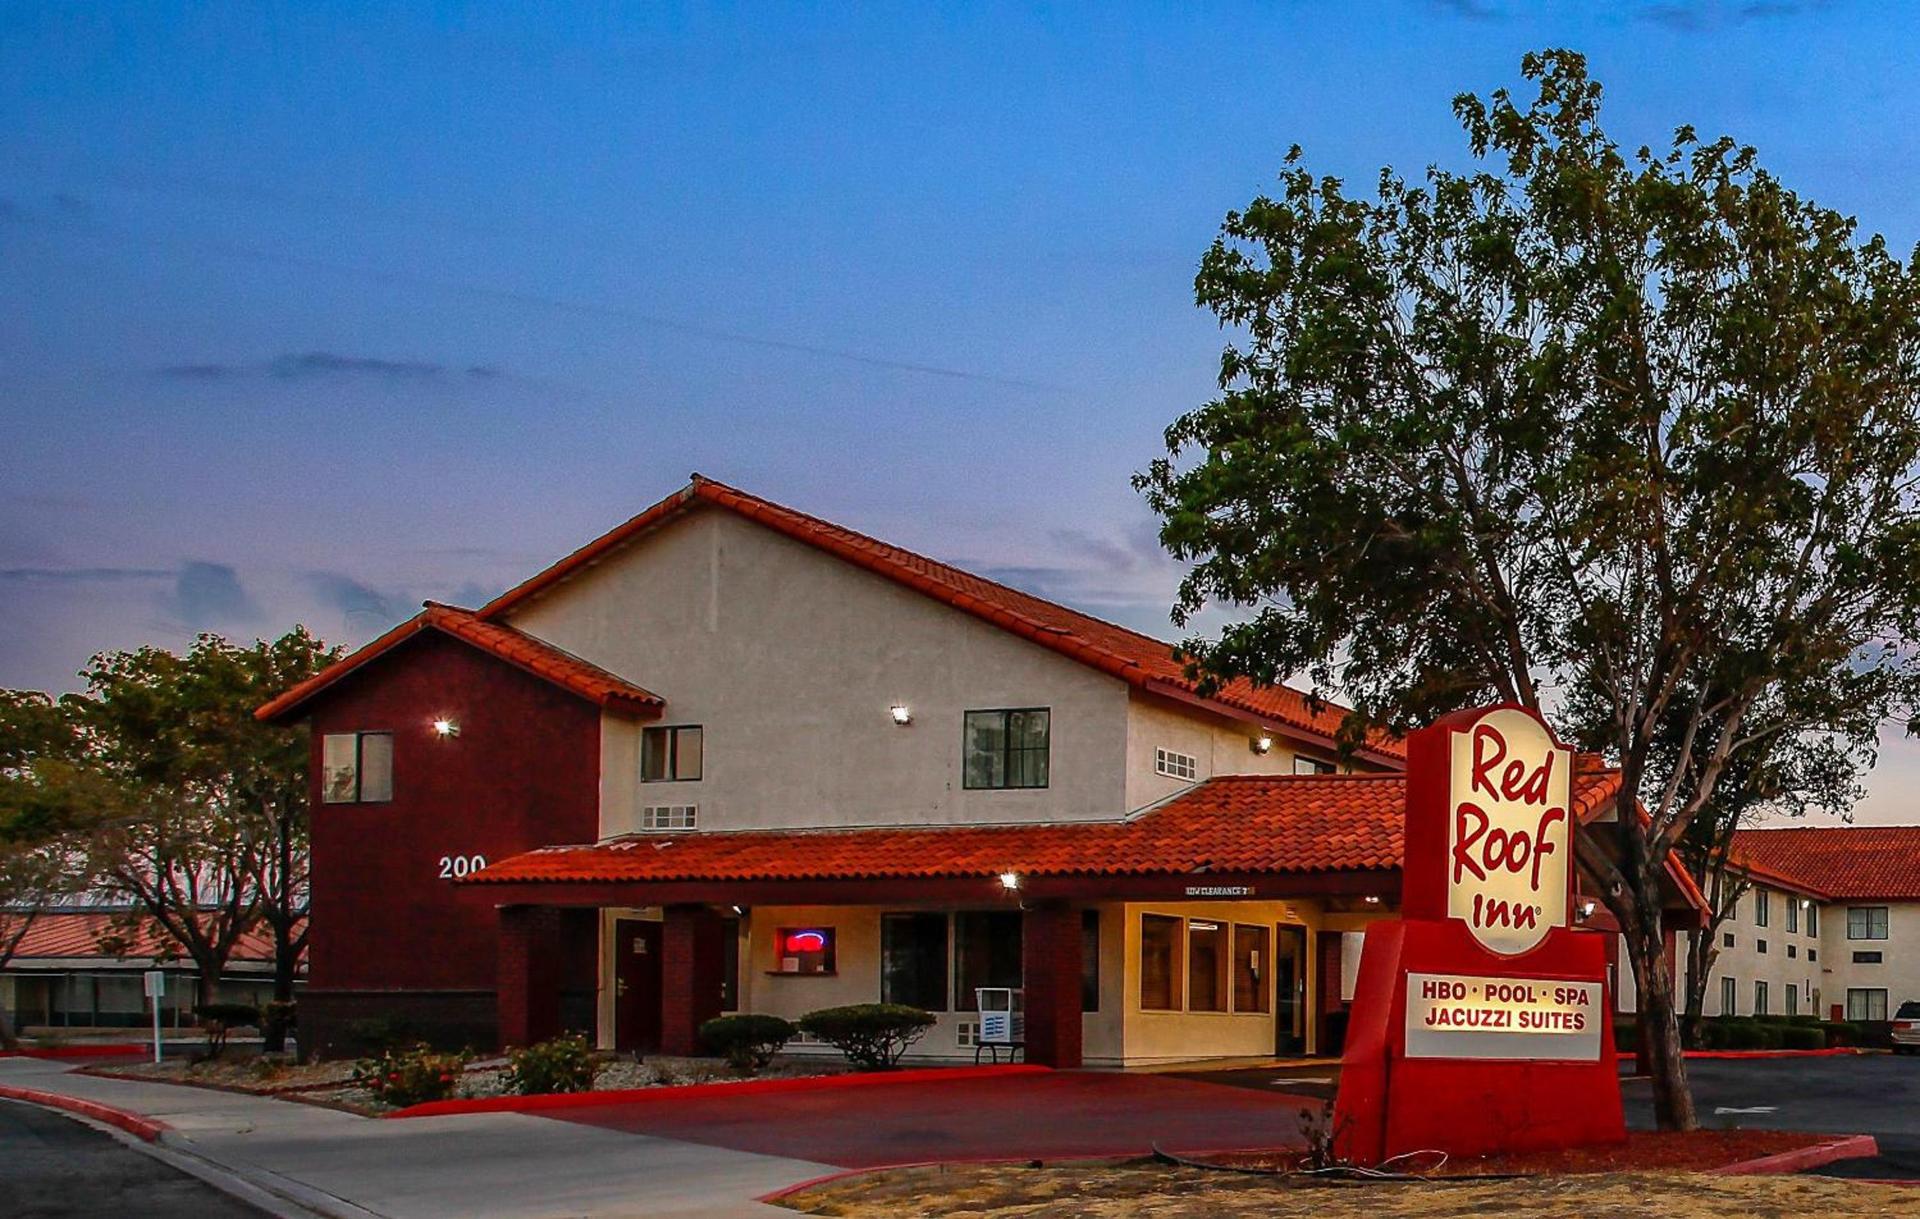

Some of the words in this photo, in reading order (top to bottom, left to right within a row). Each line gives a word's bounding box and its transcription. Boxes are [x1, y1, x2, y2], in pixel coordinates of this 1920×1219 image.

[1472, 724, 1555, 805] Red
[1453, 802, 1565, 891] Roof
[439, 855, 486, 878] 200
[1422, 980, 1467, 1001] HBO
[1485, 984, 1537, 1004] POOL
[1554, 987, 1590, 1006] SPA
[1425, 1007, 1511, 1028] JACUZZI
[1519, 1011, 1586, 1030] SUITES
